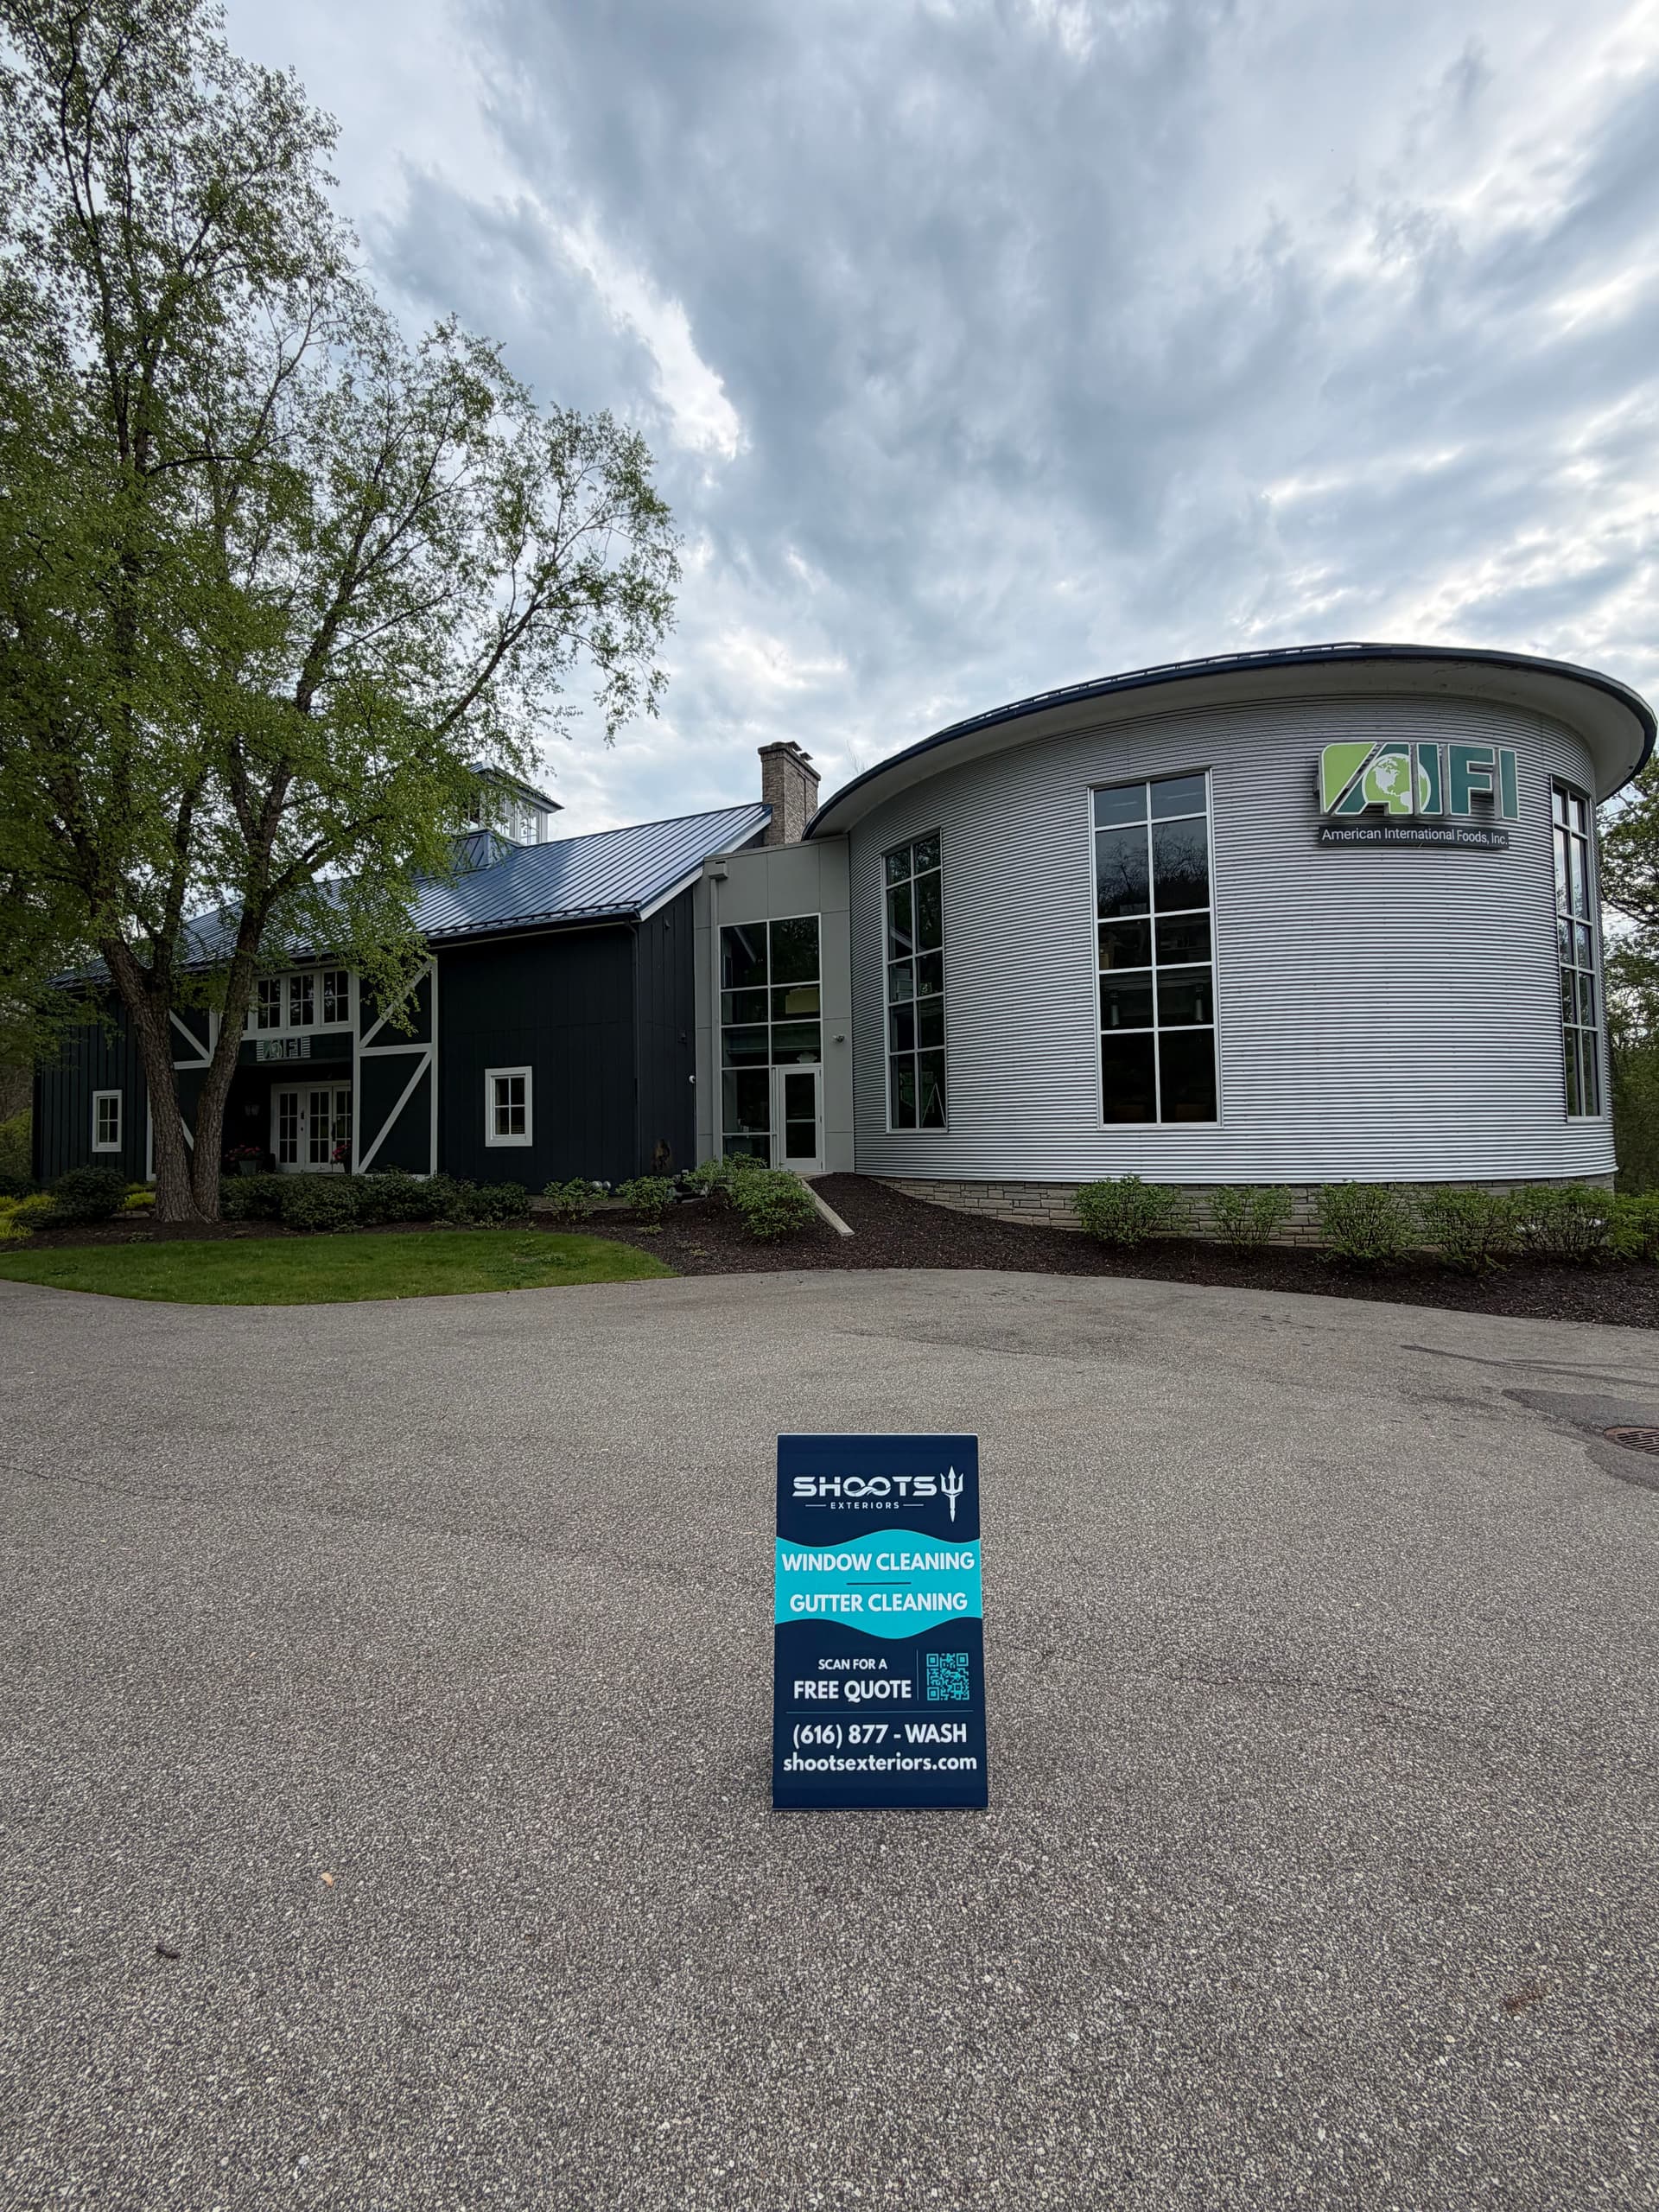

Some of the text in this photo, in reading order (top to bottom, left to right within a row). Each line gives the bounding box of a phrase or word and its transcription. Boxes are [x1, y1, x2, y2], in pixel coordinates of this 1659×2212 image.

[1322, 828, 1509, 845] American International Foods, Inc.
[792, 1476, 938, 1497] SHOOTS
[781, 1552, 975, 1572] WINDOW CLEANING
[790, 1592, 968, 1612] GUTTER CLEANING
[818, 1658, 888, 1669] SCAN FOR A
[793, 1680, 912, 1703] FREE QUOTE
[792, 1724, 843, 1749] (616)
[848, 1724, 889, 1744] 877
[905, 1723, 967, 1743] WASH
[783, 1751, 977, 1771] shootsexteriors.com
